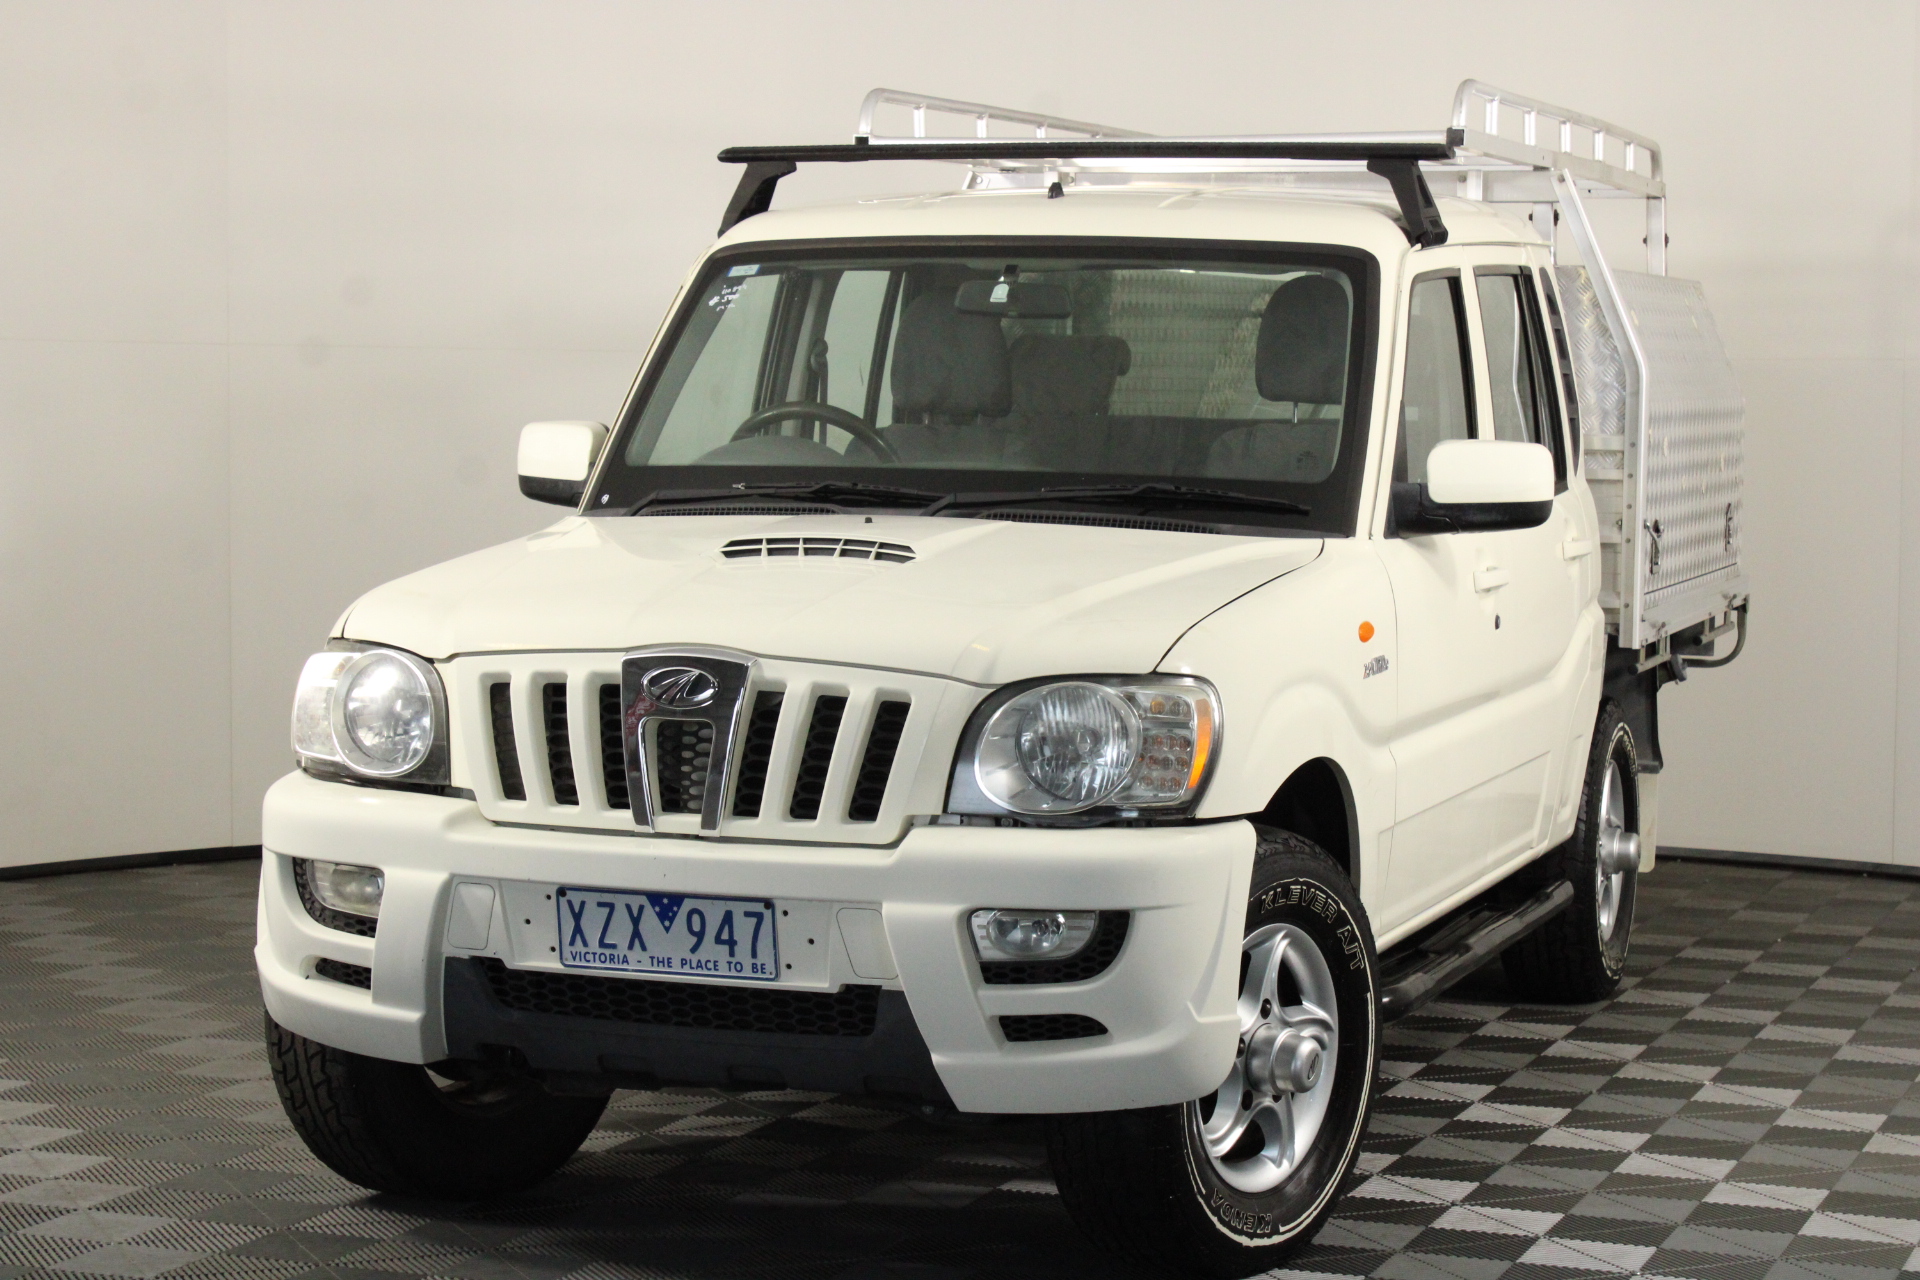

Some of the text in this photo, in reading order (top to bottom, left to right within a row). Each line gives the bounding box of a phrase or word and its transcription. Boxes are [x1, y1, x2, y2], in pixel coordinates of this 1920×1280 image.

[1260, 885, 1338, 924] KLEVER
[566, 899, 765, 959] XZX 947
[570, 950, 630, 966] VICTORIA
[649, 955, 674, 969] THE
[680, 958, 720, 972] PLACE
[726, 960, 744, 974] TO
[751, 962, 767, 975] BE
[1211, 1187, 1273, 1233] KENDA
